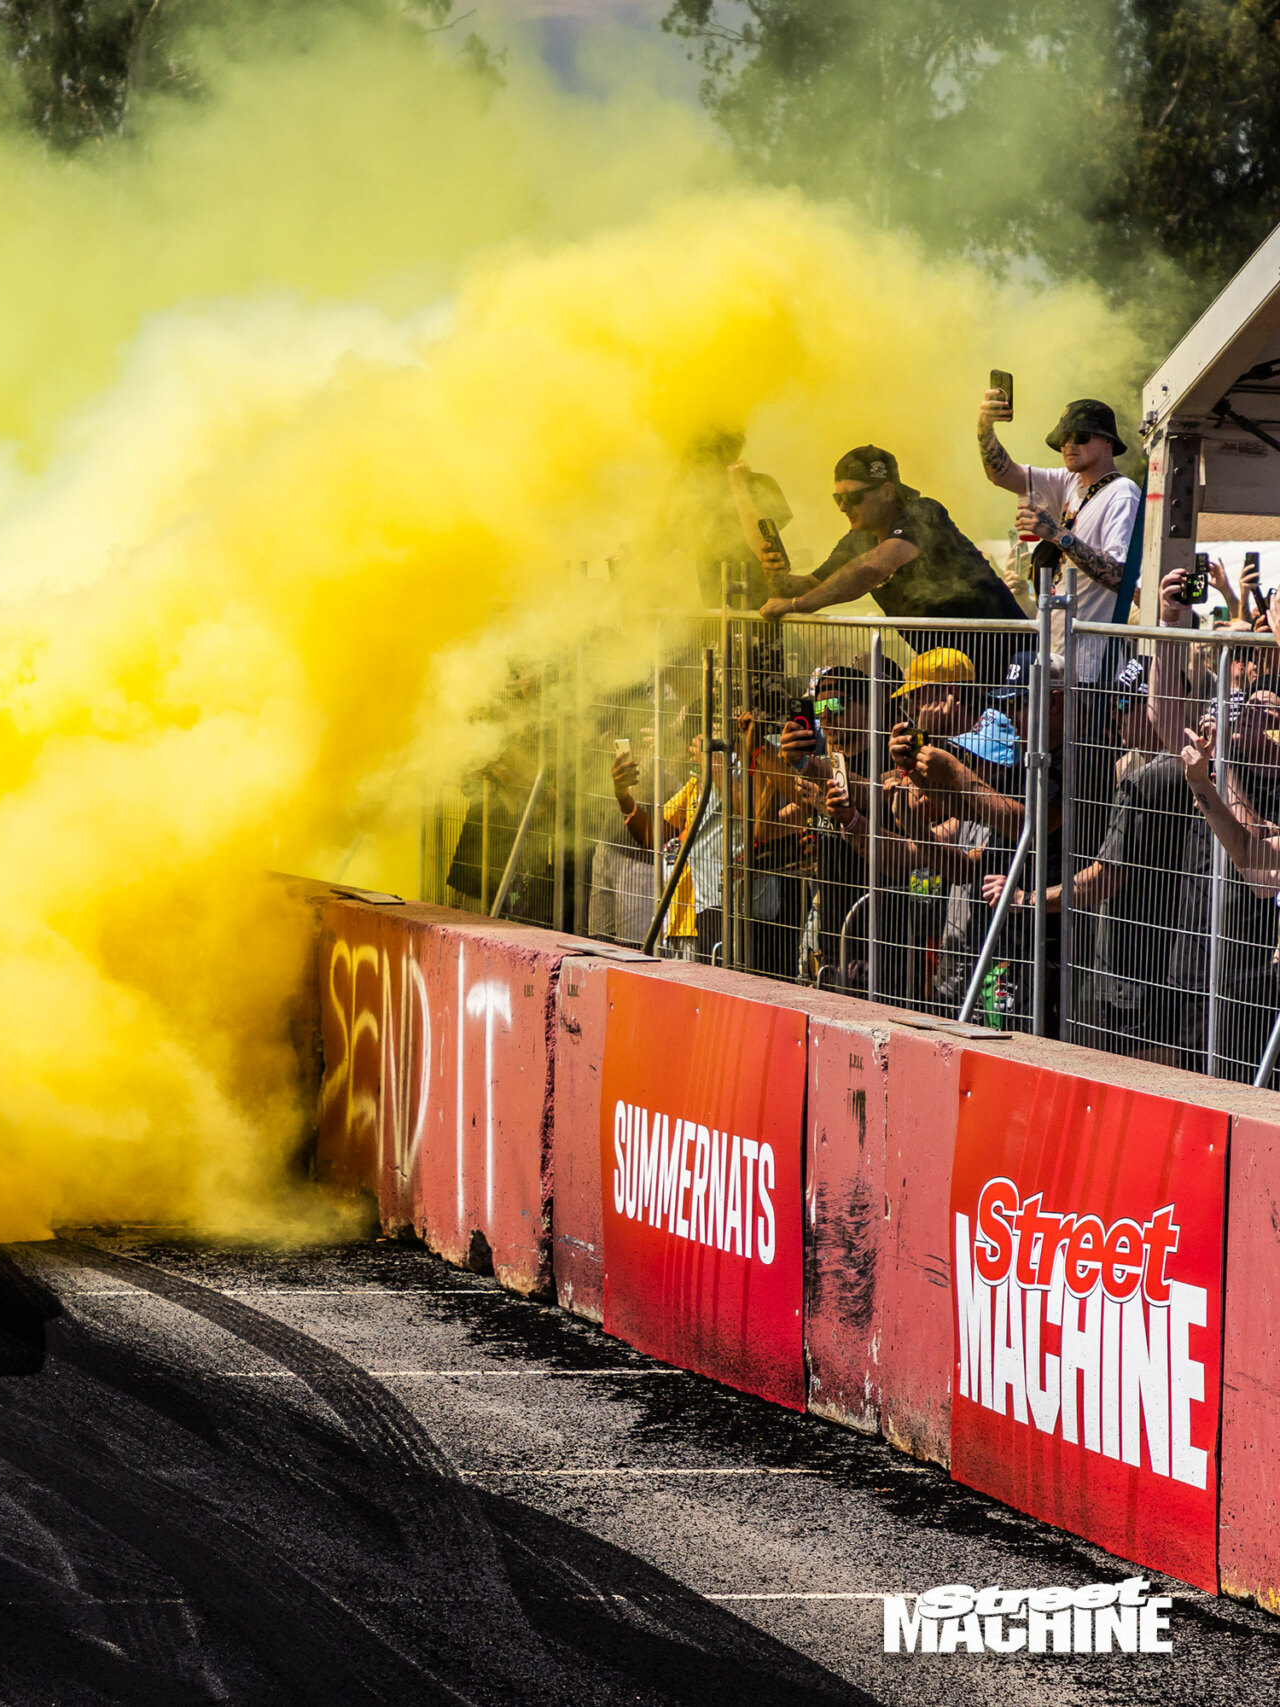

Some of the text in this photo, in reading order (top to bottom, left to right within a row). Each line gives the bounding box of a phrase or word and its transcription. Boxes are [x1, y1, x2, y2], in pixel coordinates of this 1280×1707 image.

[457, 941, 512, 1233] IT
[613, 1100, 775, 1265] SUMMERNATS
[956, 1211, 1207, 1490] MACHINE
[976, 1176, 1179, 1307] Street
